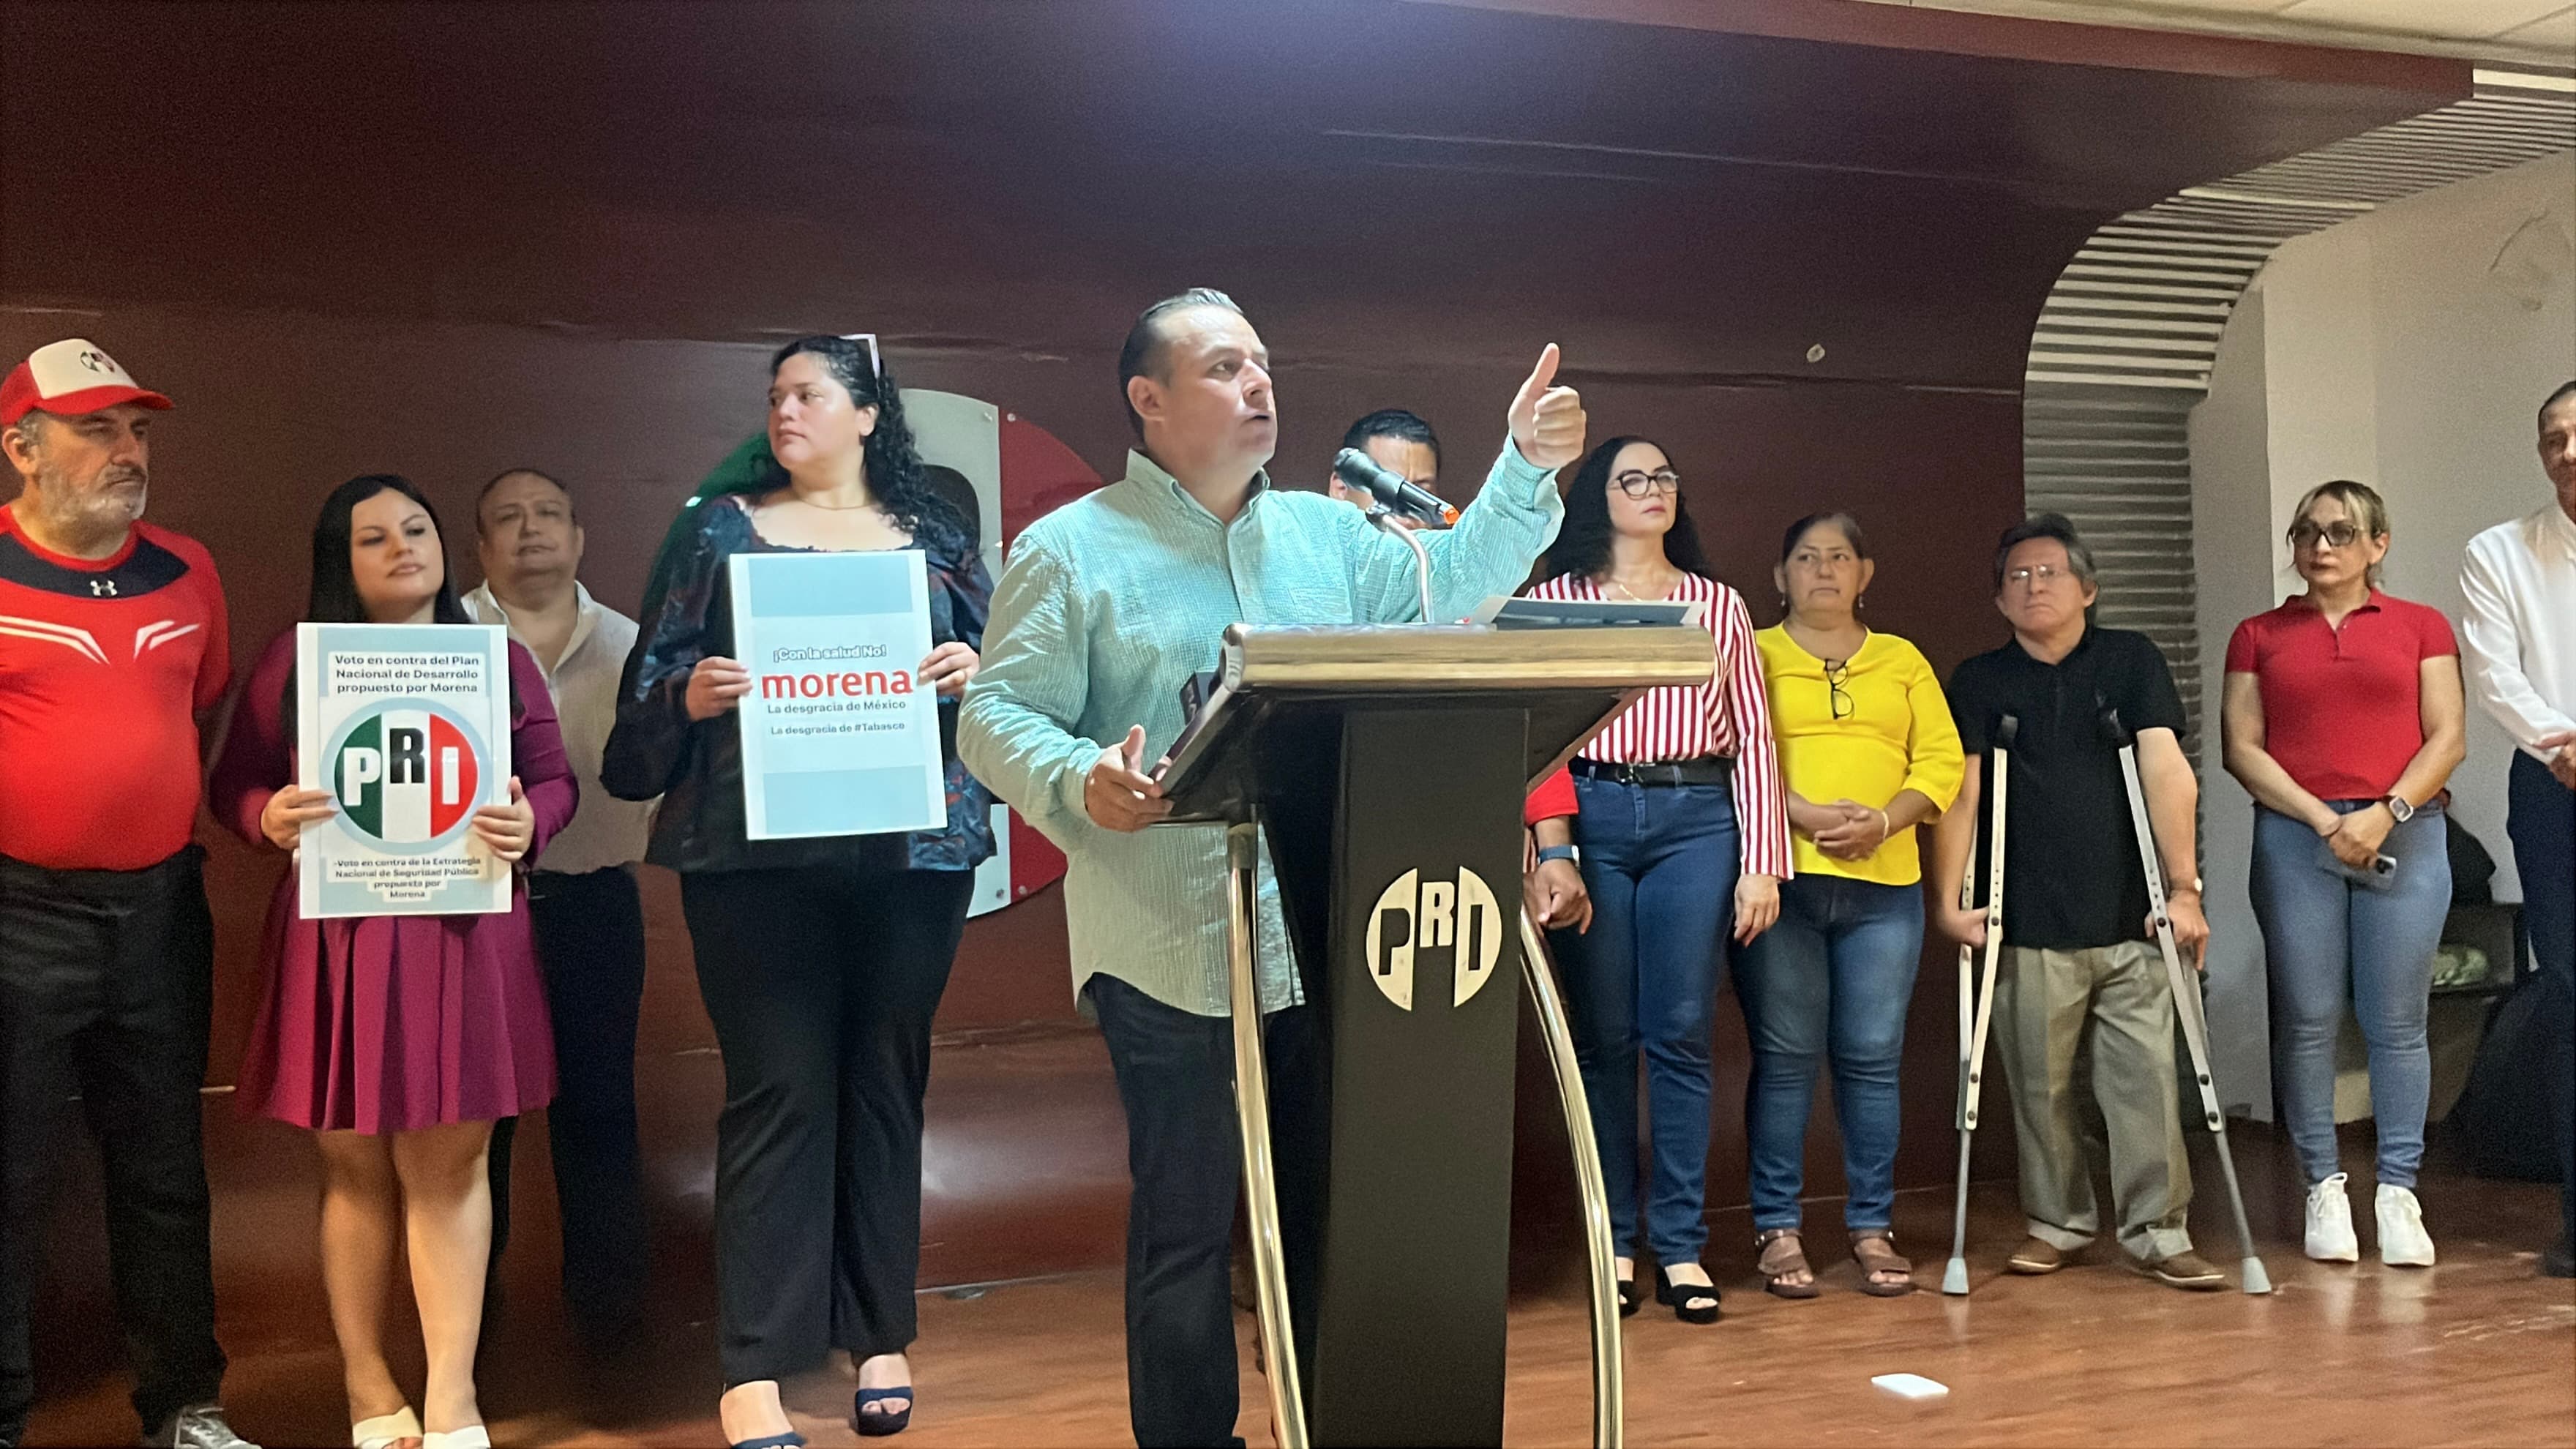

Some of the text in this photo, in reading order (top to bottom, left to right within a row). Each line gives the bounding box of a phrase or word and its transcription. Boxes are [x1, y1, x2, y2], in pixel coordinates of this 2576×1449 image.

[774, 644, 887, 662] ¡Con la salud No!
[335, 655, 479, 665] Voto en contra del Plan
[336, 669, 478, 678] Nacional de Desarrollo
[337, 684, 477, 694] propuesto por Morena
[762, 670, 913, 699] morena
[768, 700, 907, 714] La desgracia de México
[771, 721, 905, 735] La desgracia de #Tabasco
[343, 727, 460, 806] PRI
[433, 857, 481, 866] Estrategia
[336, 868, 479, 877] Nacional de Seguridad Pública
[425, 880, 441, 888] por
[390, 890, 425, 898] Morena
[1378, 881, 1483, 976] PRI
